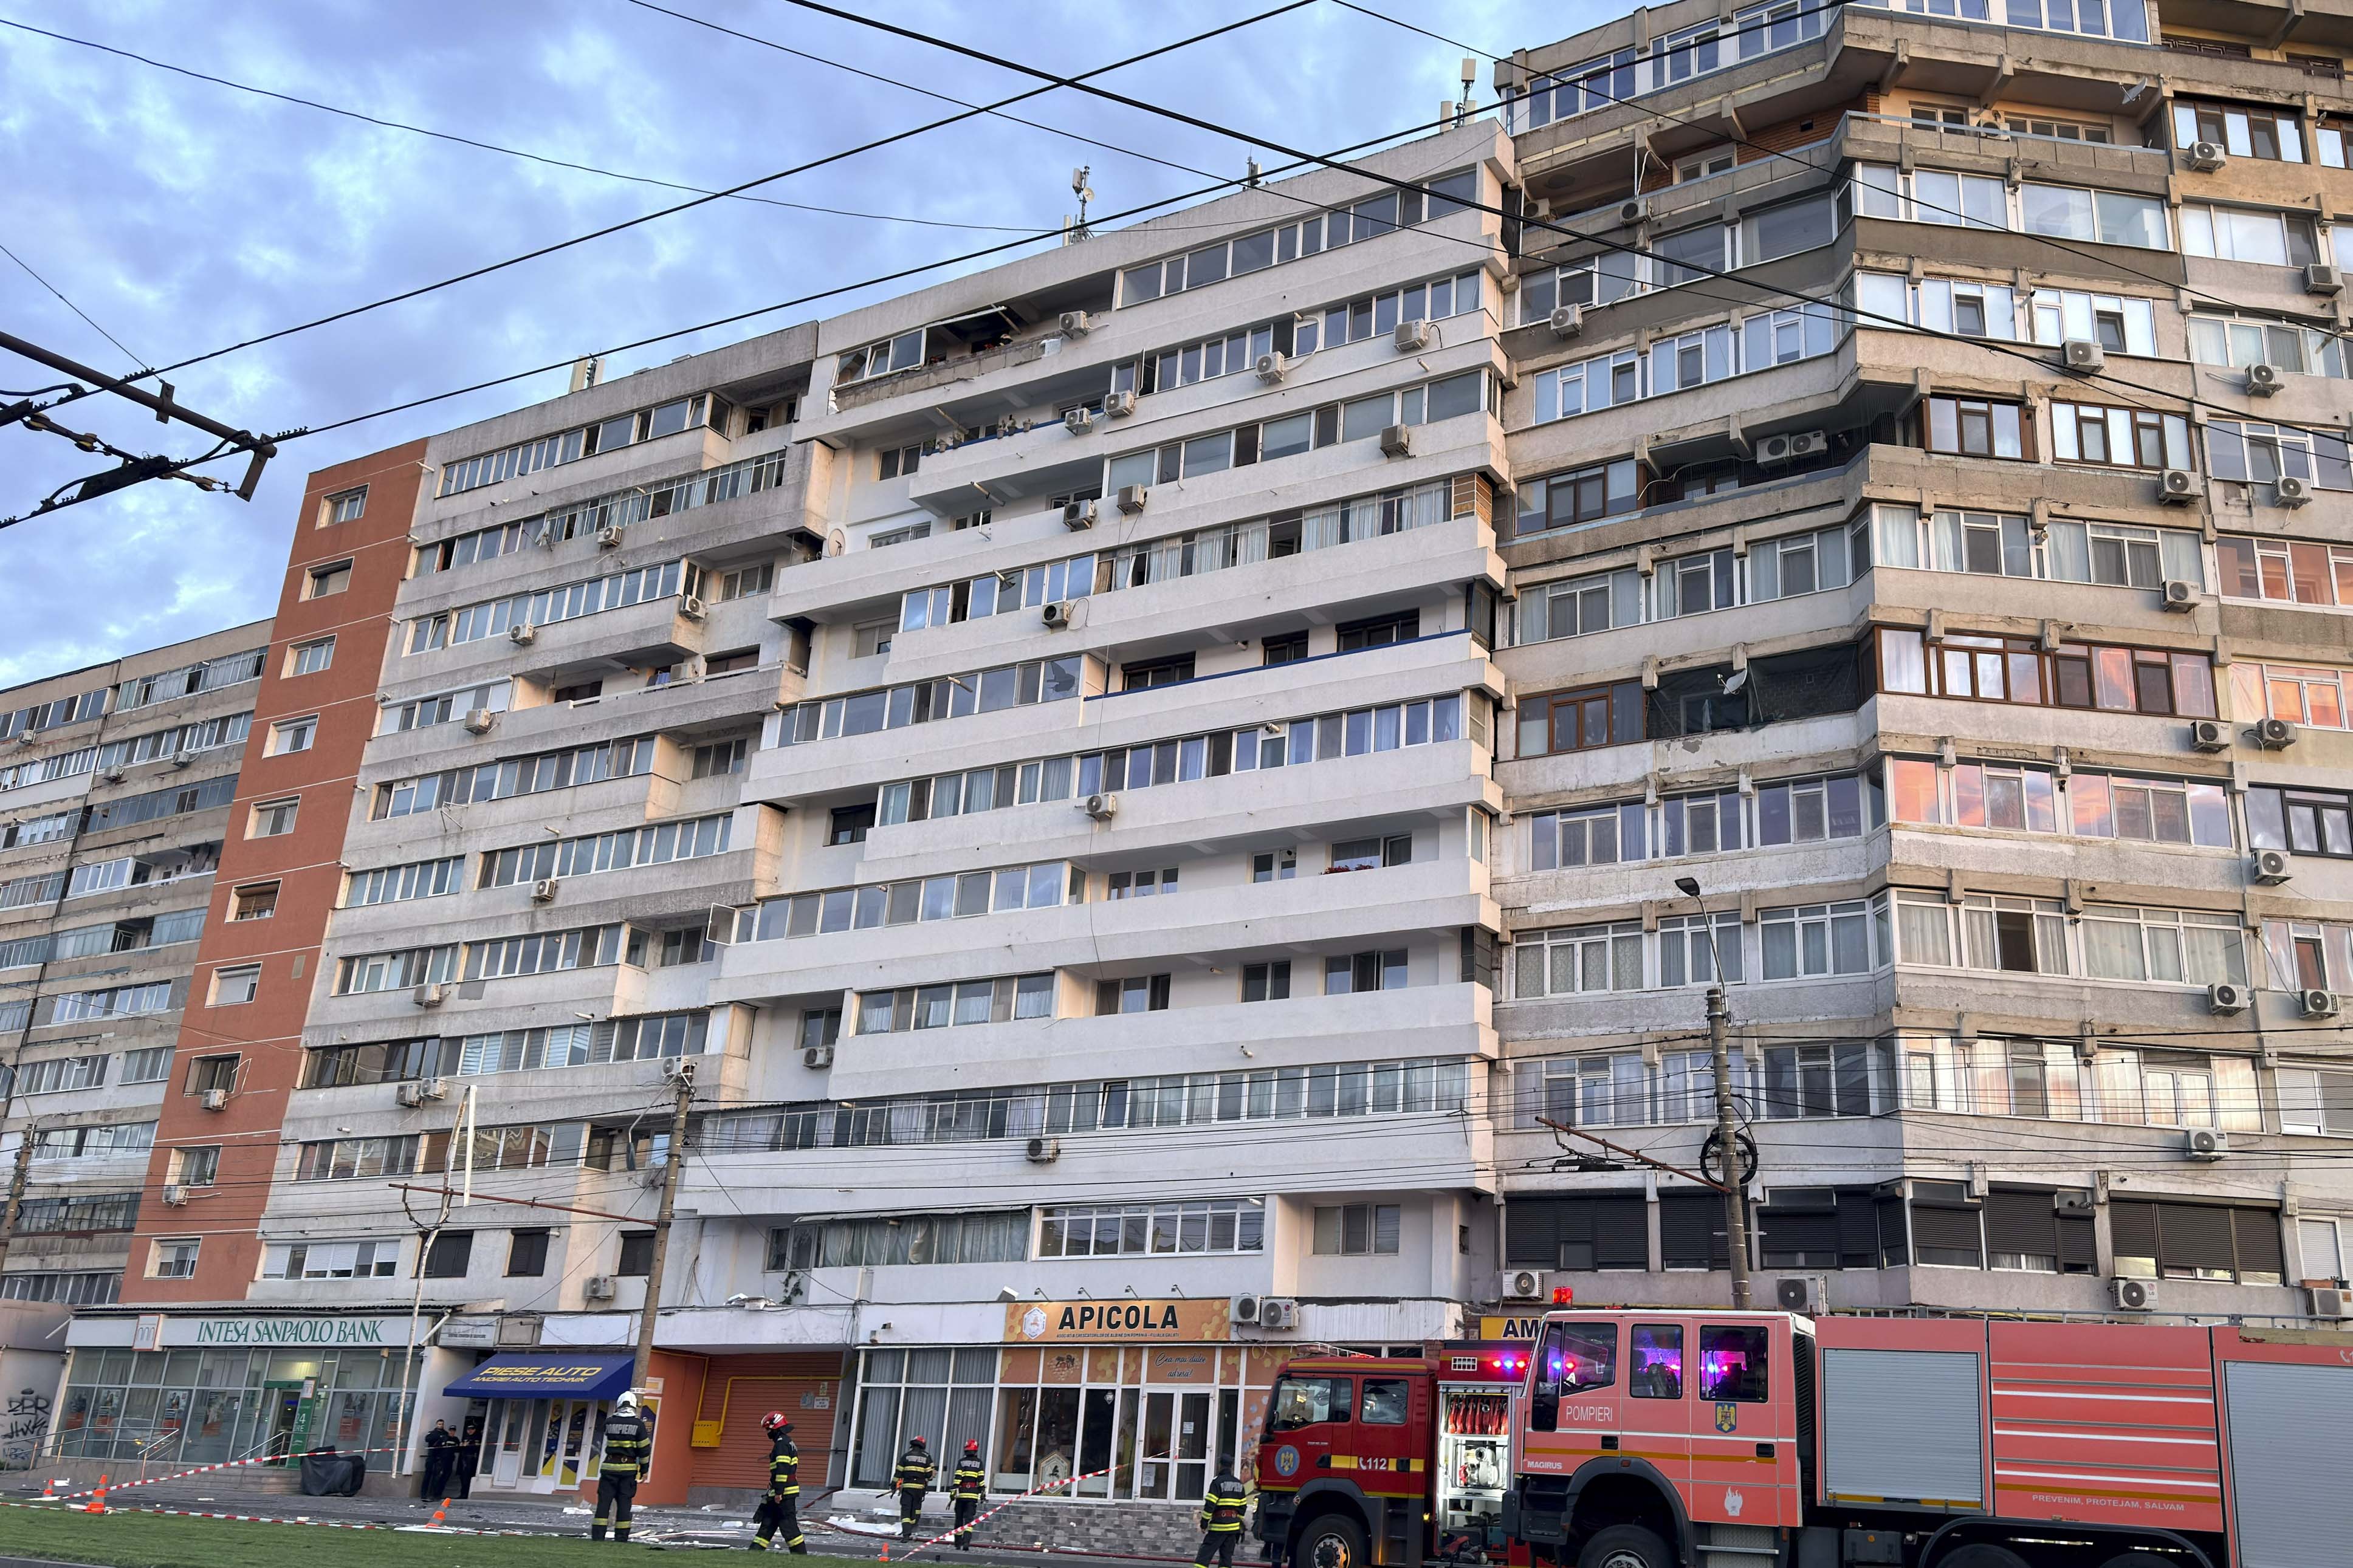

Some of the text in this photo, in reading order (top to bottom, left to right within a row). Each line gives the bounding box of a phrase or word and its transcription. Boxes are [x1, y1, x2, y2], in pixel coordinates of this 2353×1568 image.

[1058, 1305, 1179, 1330] APICOLA
[196, 1320, 385, 1343] INTESA SANPAOLO BANK
[1155, 1352, 1172, 1366] Cea
[1189, 1352, 1206, 1363] dulce
[479, 1367, 602, 1376] PIESE AUTO
[1566, 1405, 1613, 1422] POMPIERI
[1367, 1457, 1387, 1470] 112
[1527, 1460, 1562, 1470] MAGIRUS
[2032, 1494, 2185, 1511] PREVENIM, PROTEJAM, SALVAM
